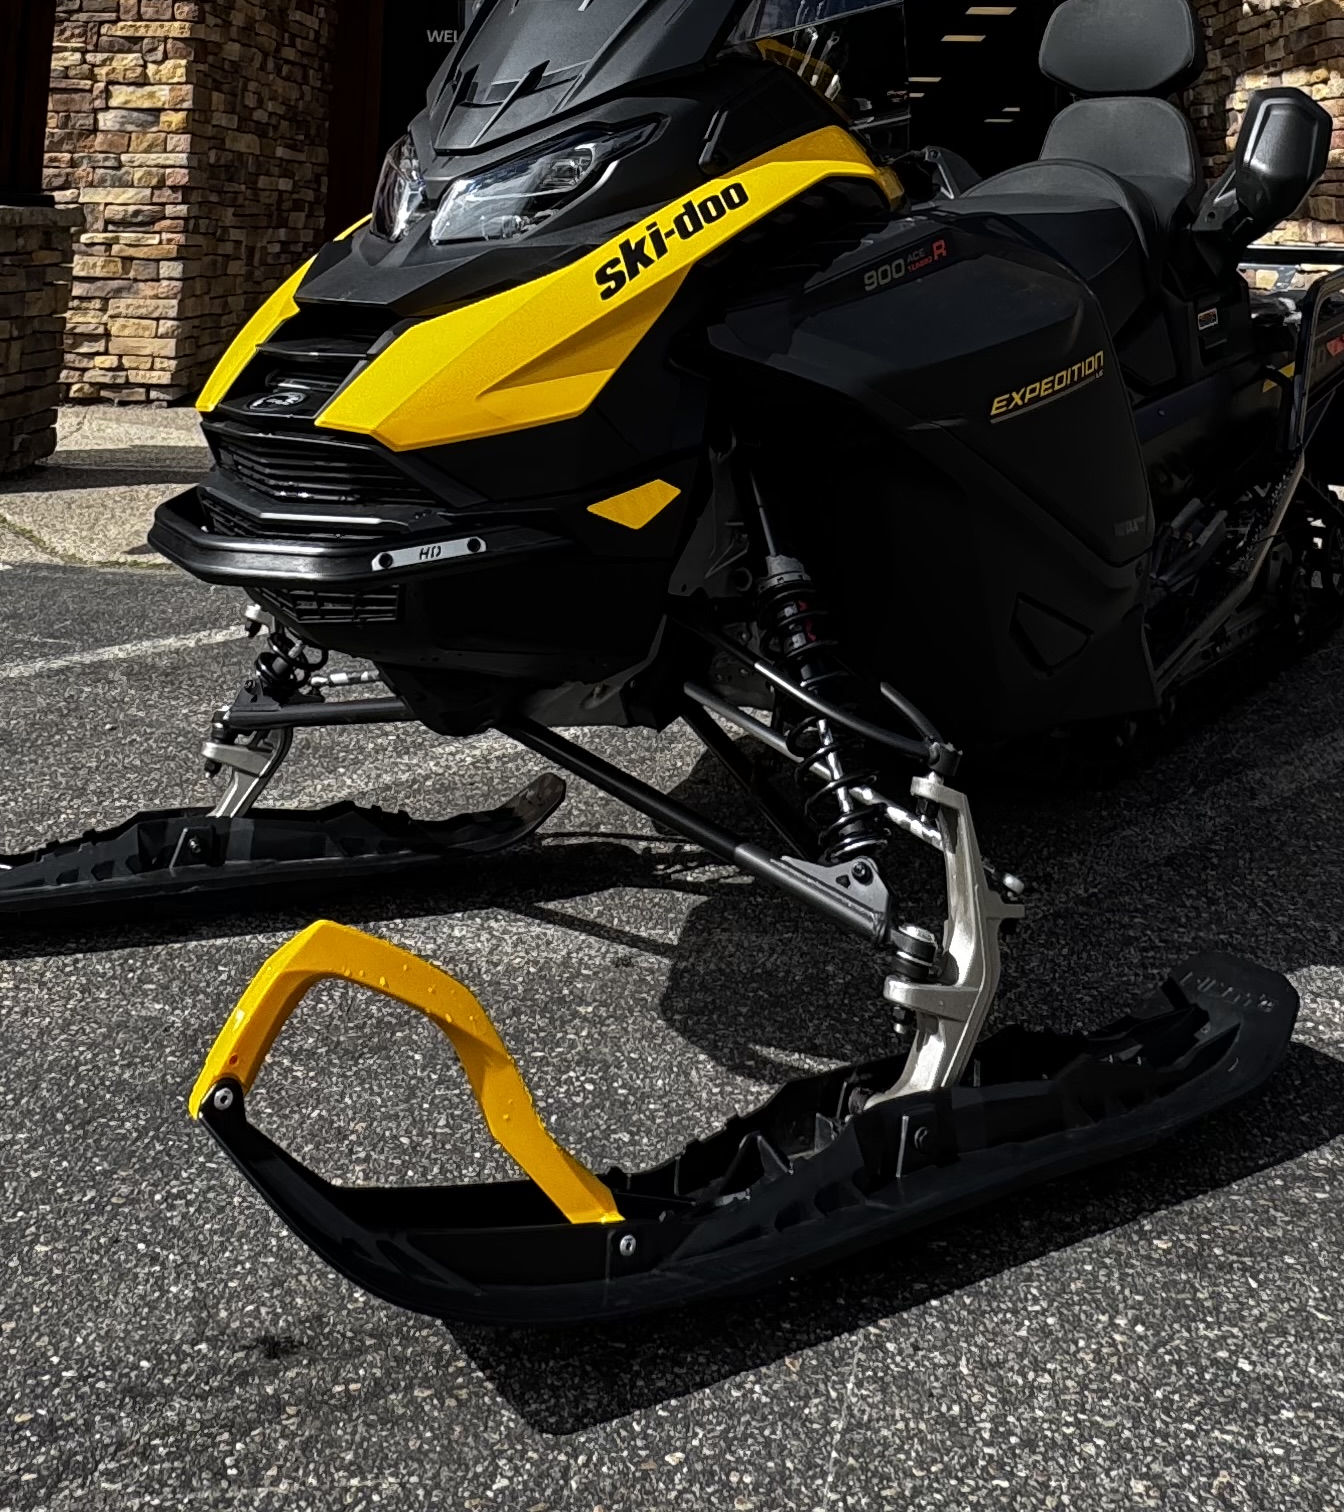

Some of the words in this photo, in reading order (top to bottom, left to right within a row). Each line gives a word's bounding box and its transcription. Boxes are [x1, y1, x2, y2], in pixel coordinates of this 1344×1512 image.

[594, 182, 749, 301] ski-doo
[864, 257, 905, 291] 900
[990, 350, 1104, 416] EXPEDITION
[419, 545, 442, 561] HD
